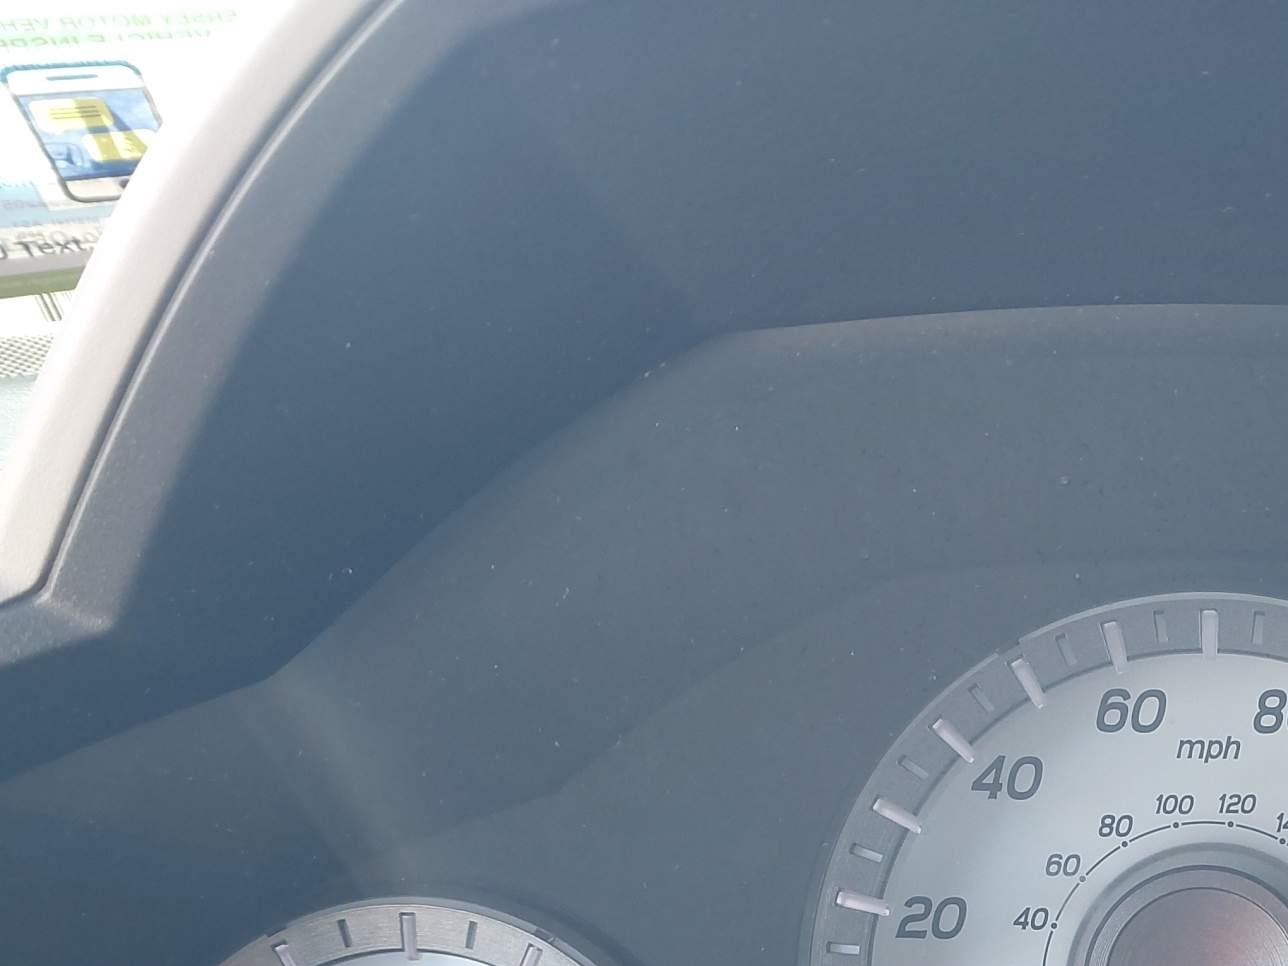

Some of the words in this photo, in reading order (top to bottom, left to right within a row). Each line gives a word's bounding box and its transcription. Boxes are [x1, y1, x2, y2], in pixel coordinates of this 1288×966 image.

[1097, 689, 1166, 733] 60
[1177, 736, 1240, 763] mph
[971, 755, 1043, 800] 40
[1156, 795, 1194, 814] 100
[1219, 794, 1256, 814] 120
[1099, 815, 1133, 837] 80
[1046, 854, 1080, 876] 60
[895, 896, 966, 939] 20
[1013, 908, 1048, 930] 40
